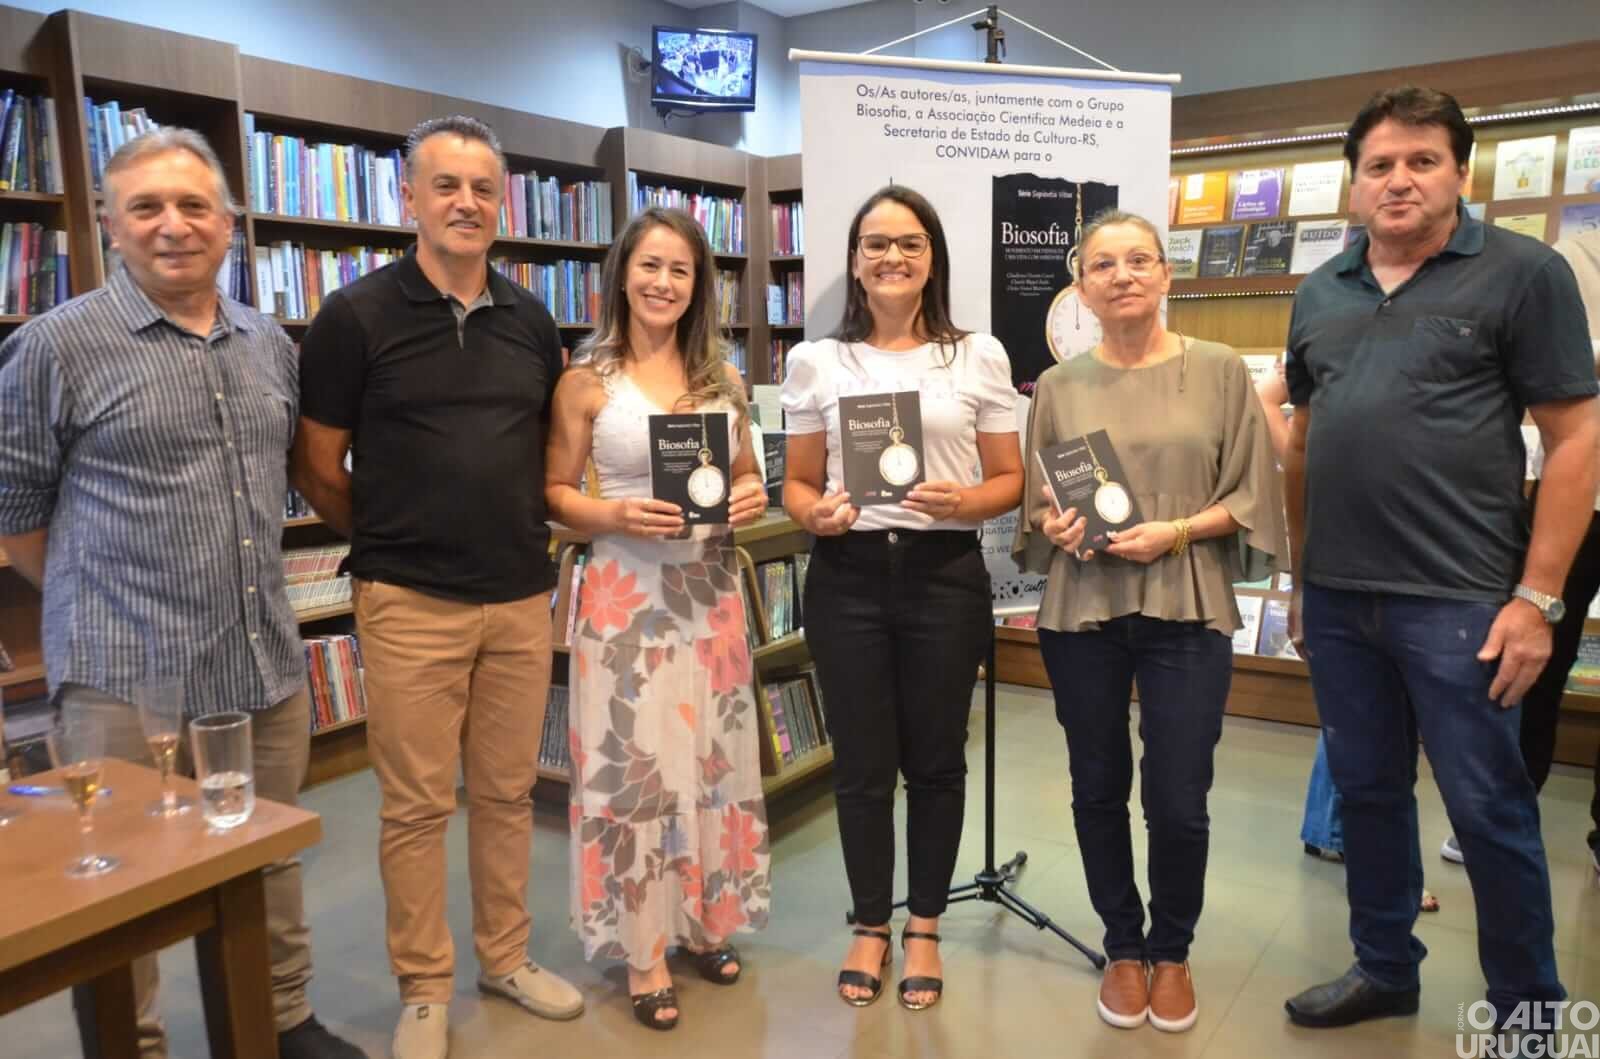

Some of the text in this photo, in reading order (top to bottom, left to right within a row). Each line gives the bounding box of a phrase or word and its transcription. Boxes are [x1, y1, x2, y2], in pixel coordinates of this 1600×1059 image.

[856, 83, 1125, 112] Os/As autores/as, juntamente com o Grupo
[856, 103, 911, 120] Biosofia,
[915, 109, 923, 120] a
[927, 107, 996, 125] Associação
[1059, 115, 1102, 129] Medeia
[1105, 119, 1113, 129] e
[1116, 119, 1124, 129] a
[883, 122, 1100, 149] Secretaria de Estado da Cultura-RS,
[935, 144, 1053, 163] CONVIDAM para o
[1001, 221, 1069, 245] Biosofia
[848, 416, 891, 431] Biosofia
[658, 437, 700, 450] Biosofia
[1055, 461, 1094, 482] Biosofia
